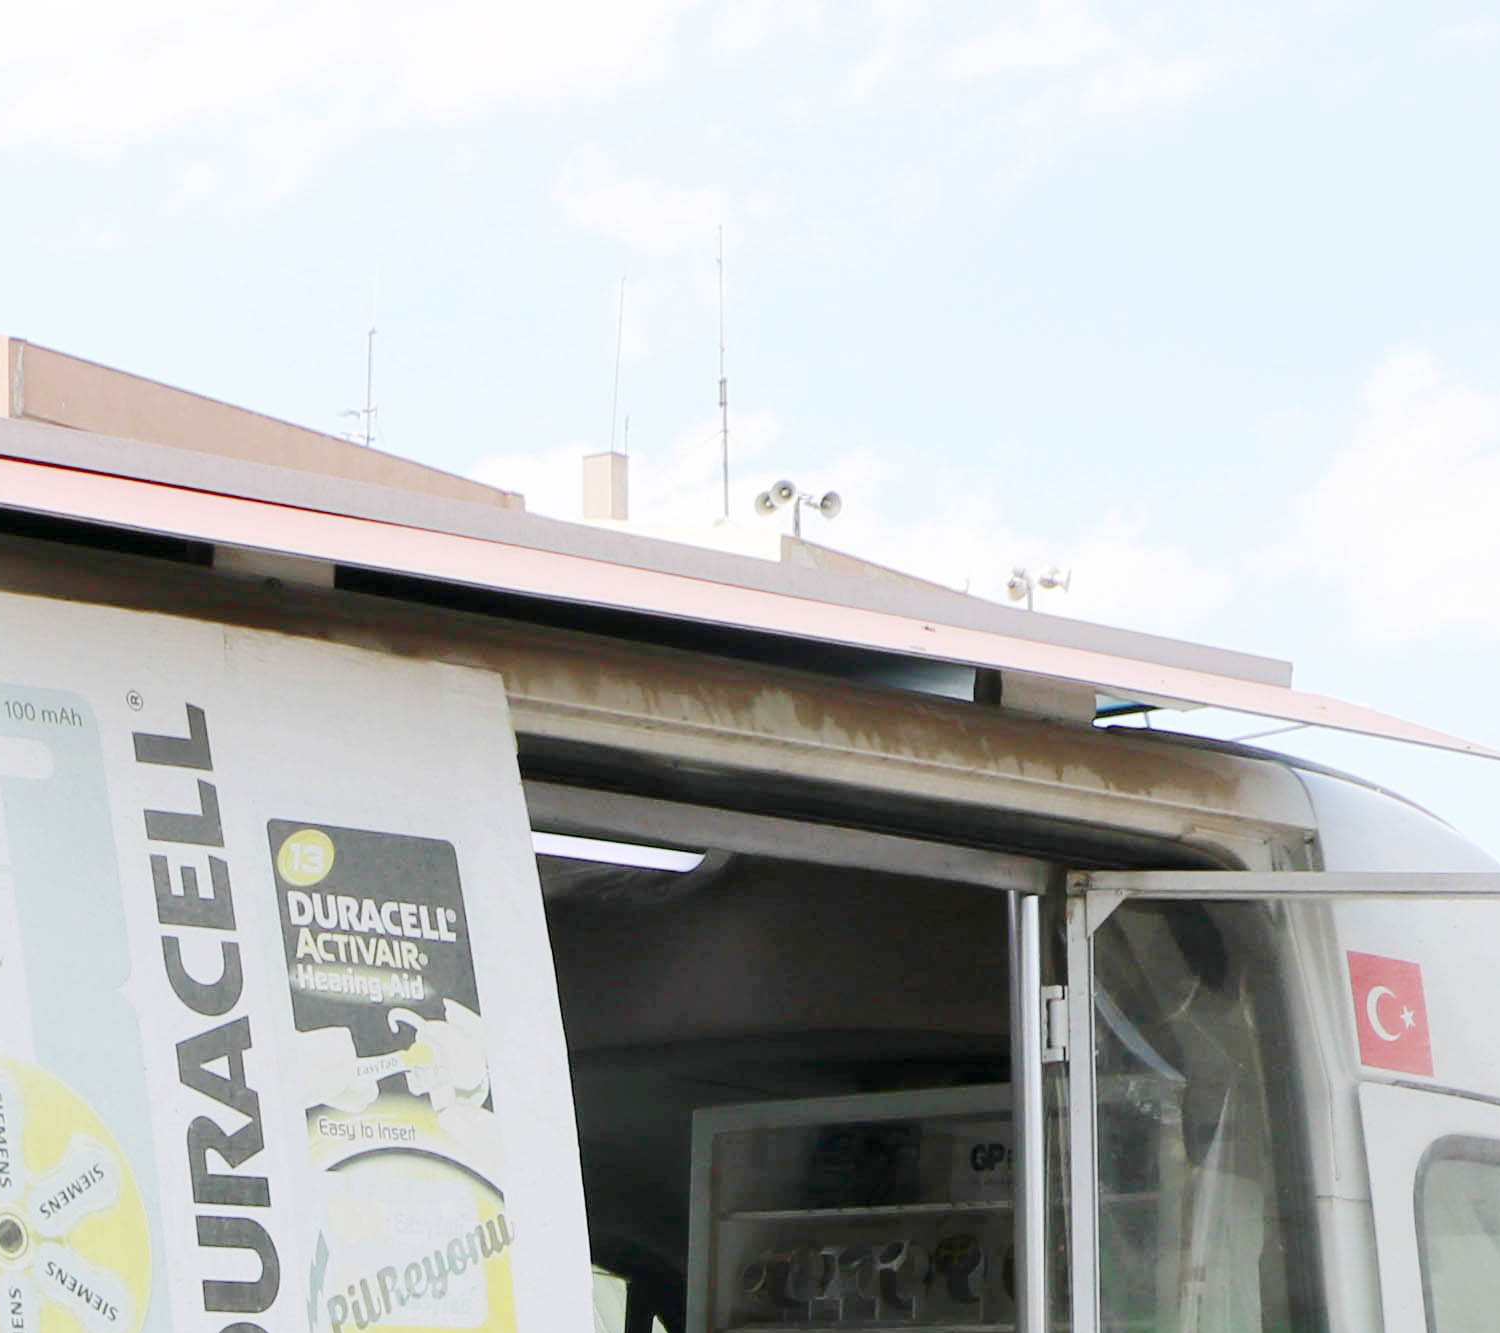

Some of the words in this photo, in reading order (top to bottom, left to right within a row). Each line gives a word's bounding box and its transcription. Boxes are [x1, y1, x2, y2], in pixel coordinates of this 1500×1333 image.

[4, 701, 36, 721] 100
[41, 707, 83, 727] mAh
[287, 890, 457, 942] DURACELL
[296, 927, 422, 971] ACTIVAIR
[296, 964, 384, 1003] Hearing
[390, 975, 425, 1001] Aid
[319, 1118, 355, 1140] Easy
[360, 1120, 374, 1138] to
[378, 1123, 416, 1142] Insert
[39, 1163, 105, 1219] SIEMENS
[45, 1261, 118, 1322] SIEMENS
